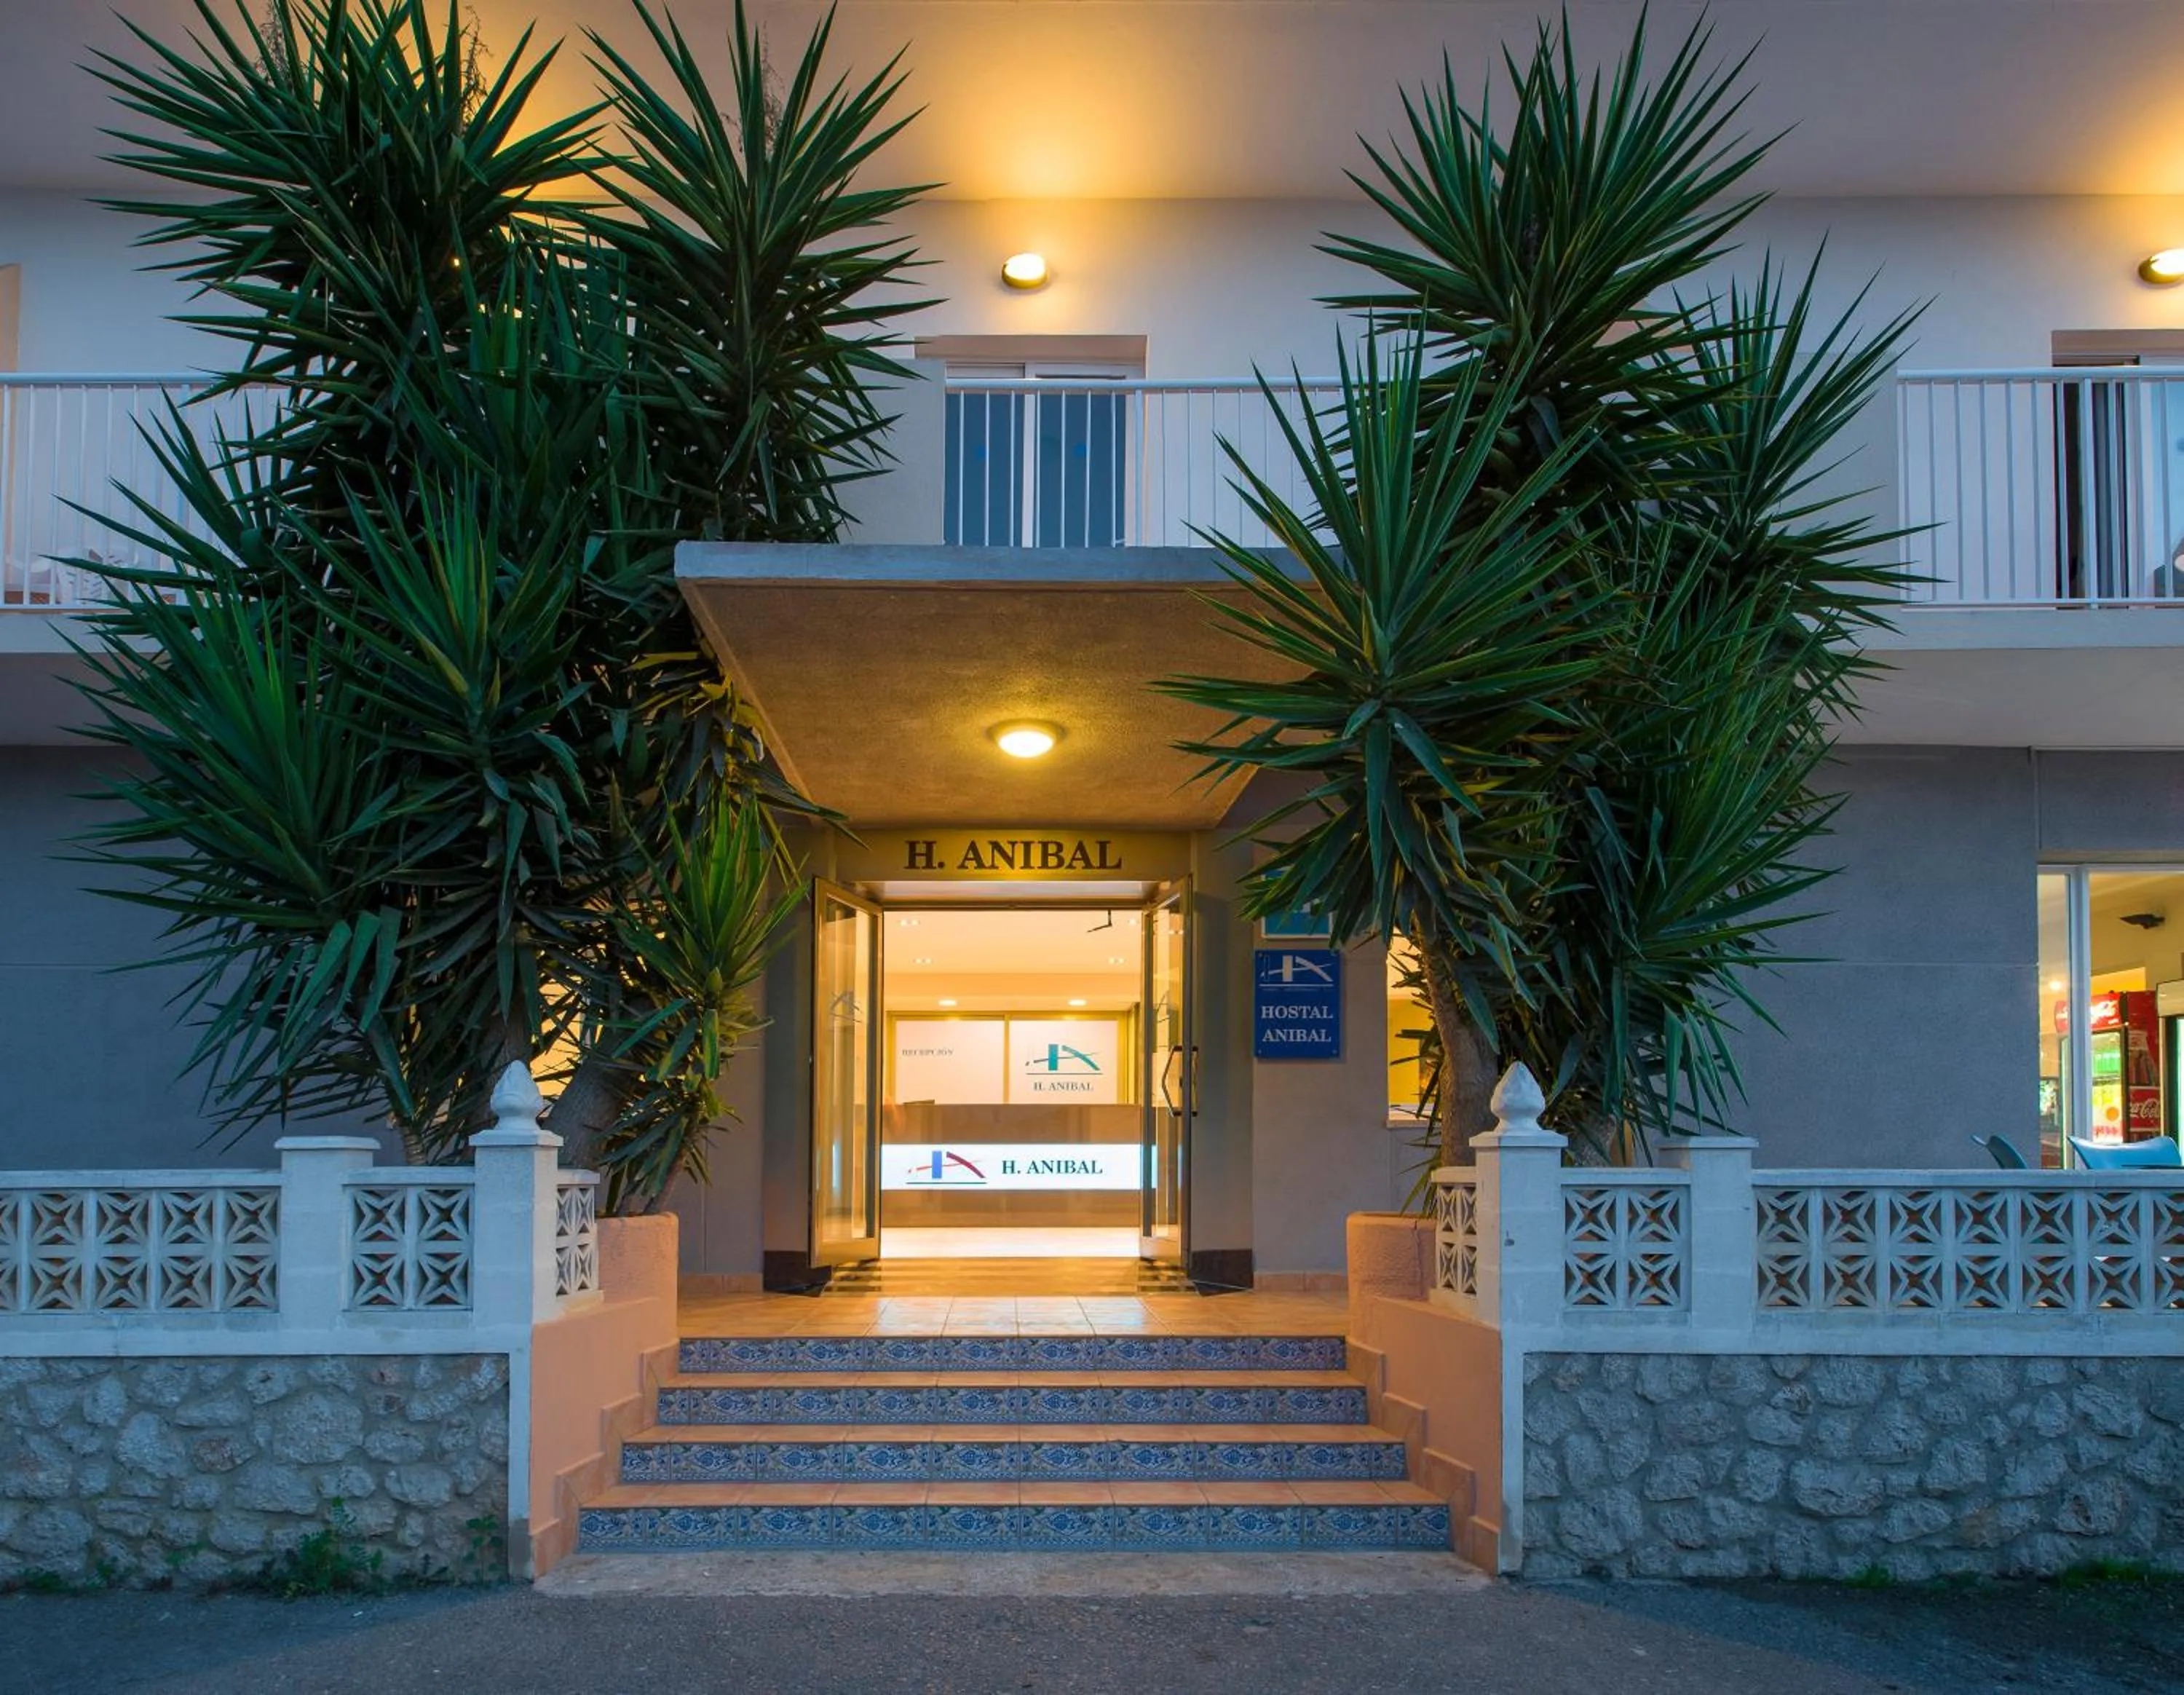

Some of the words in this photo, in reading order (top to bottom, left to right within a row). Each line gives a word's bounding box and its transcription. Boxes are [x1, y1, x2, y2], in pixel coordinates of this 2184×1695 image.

[903, 839, 945, 870] H.
[957, 839, 1122, 871] ANIBAL
[1261, 1005, 1334, 1019] HOSTAL
[1262, 1029, 1332, 1042] ANIBAL
[1049, 1081, 1093, 1091] ANIBAL
[1002, 1160, 1021, 1174] H.
[1026, 1160, 1102, 1174] ANIBAL
